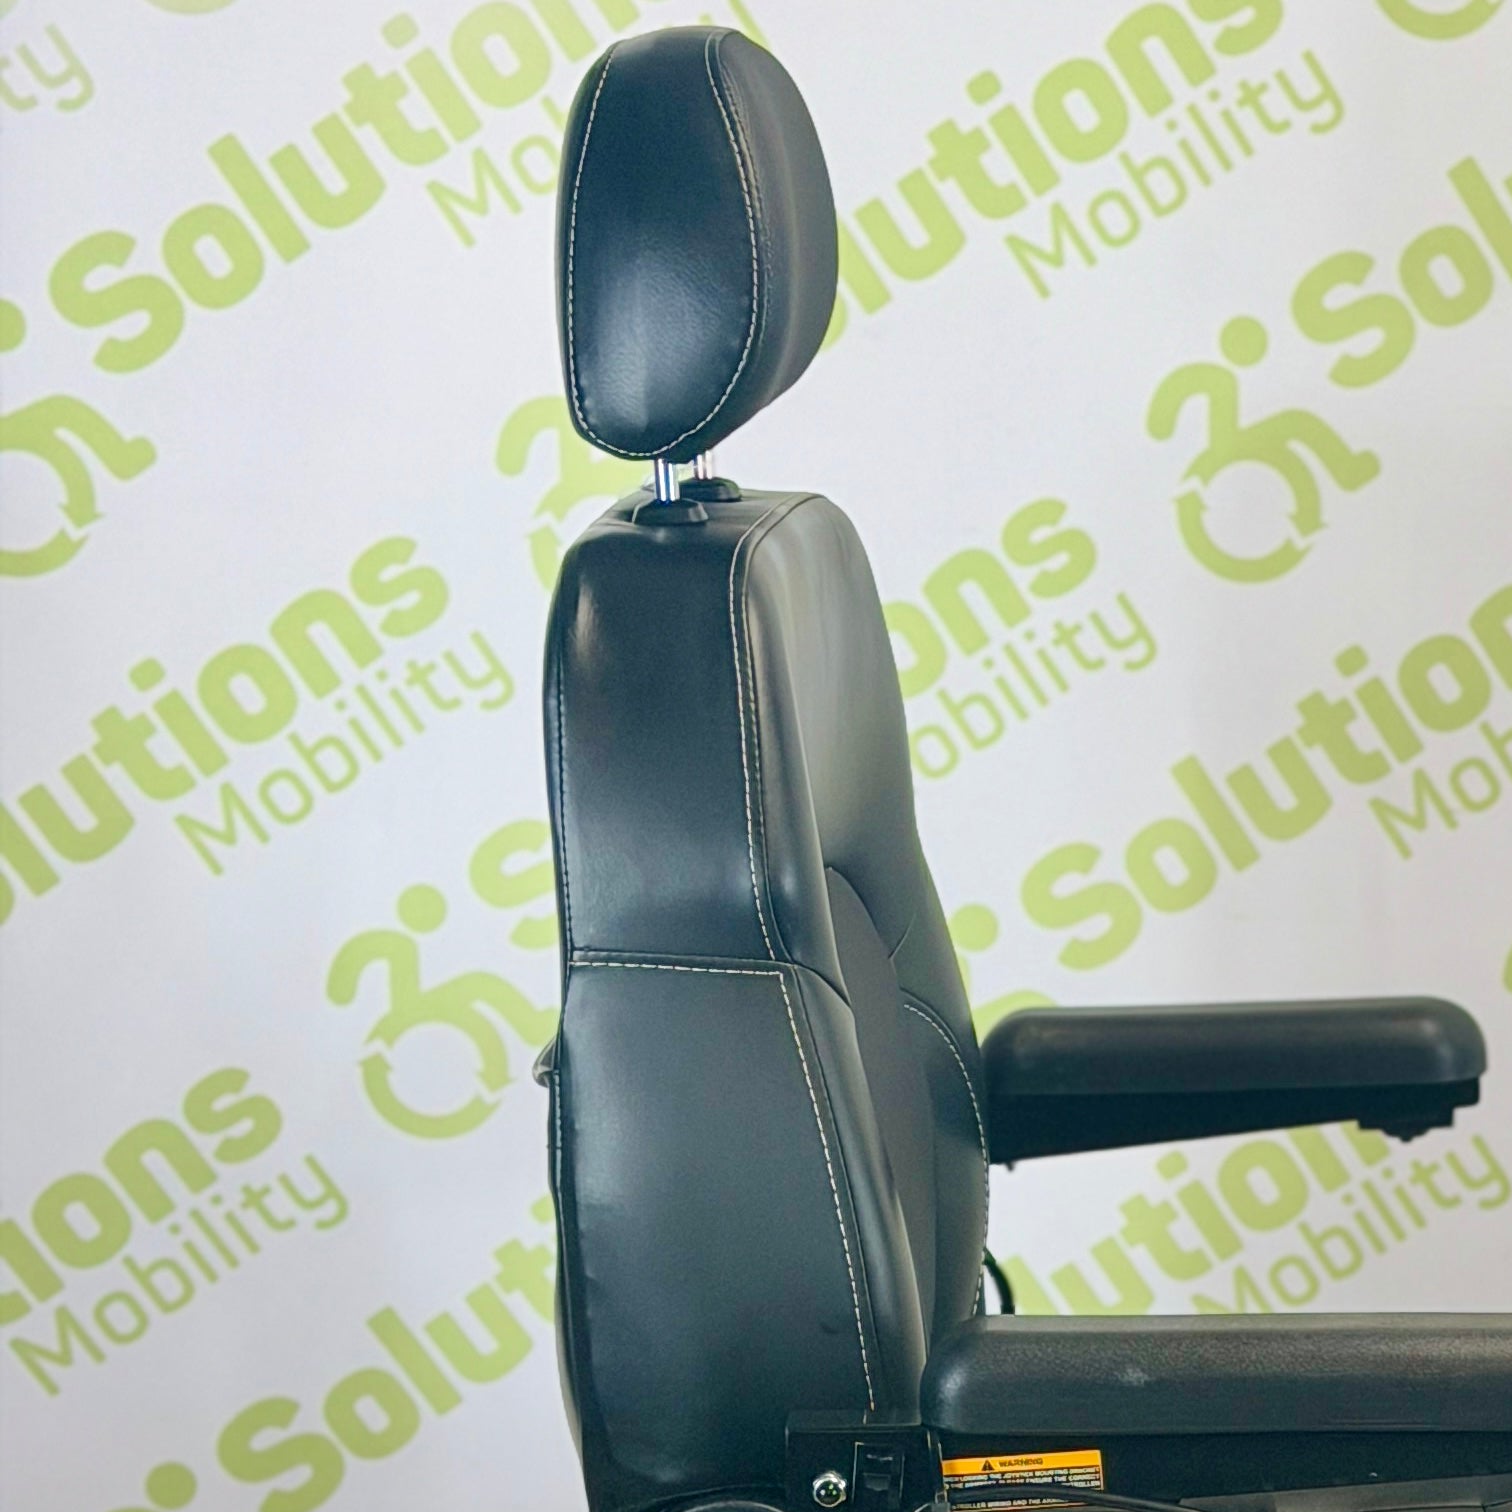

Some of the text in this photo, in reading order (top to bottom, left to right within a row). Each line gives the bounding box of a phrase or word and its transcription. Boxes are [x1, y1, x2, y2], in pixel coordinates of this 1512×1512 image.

[47, 0, 640, 375] Solutio
[819, 0, 1285, 350] lutions
[1002, 48, 1346, 300] Mobility
[0, 536, 449, 925] lutions
[174, 633, 514, 876] Mobility
[907, 592, 1158, 780] obility
[9, 1156, 348, 1397] Mobility
